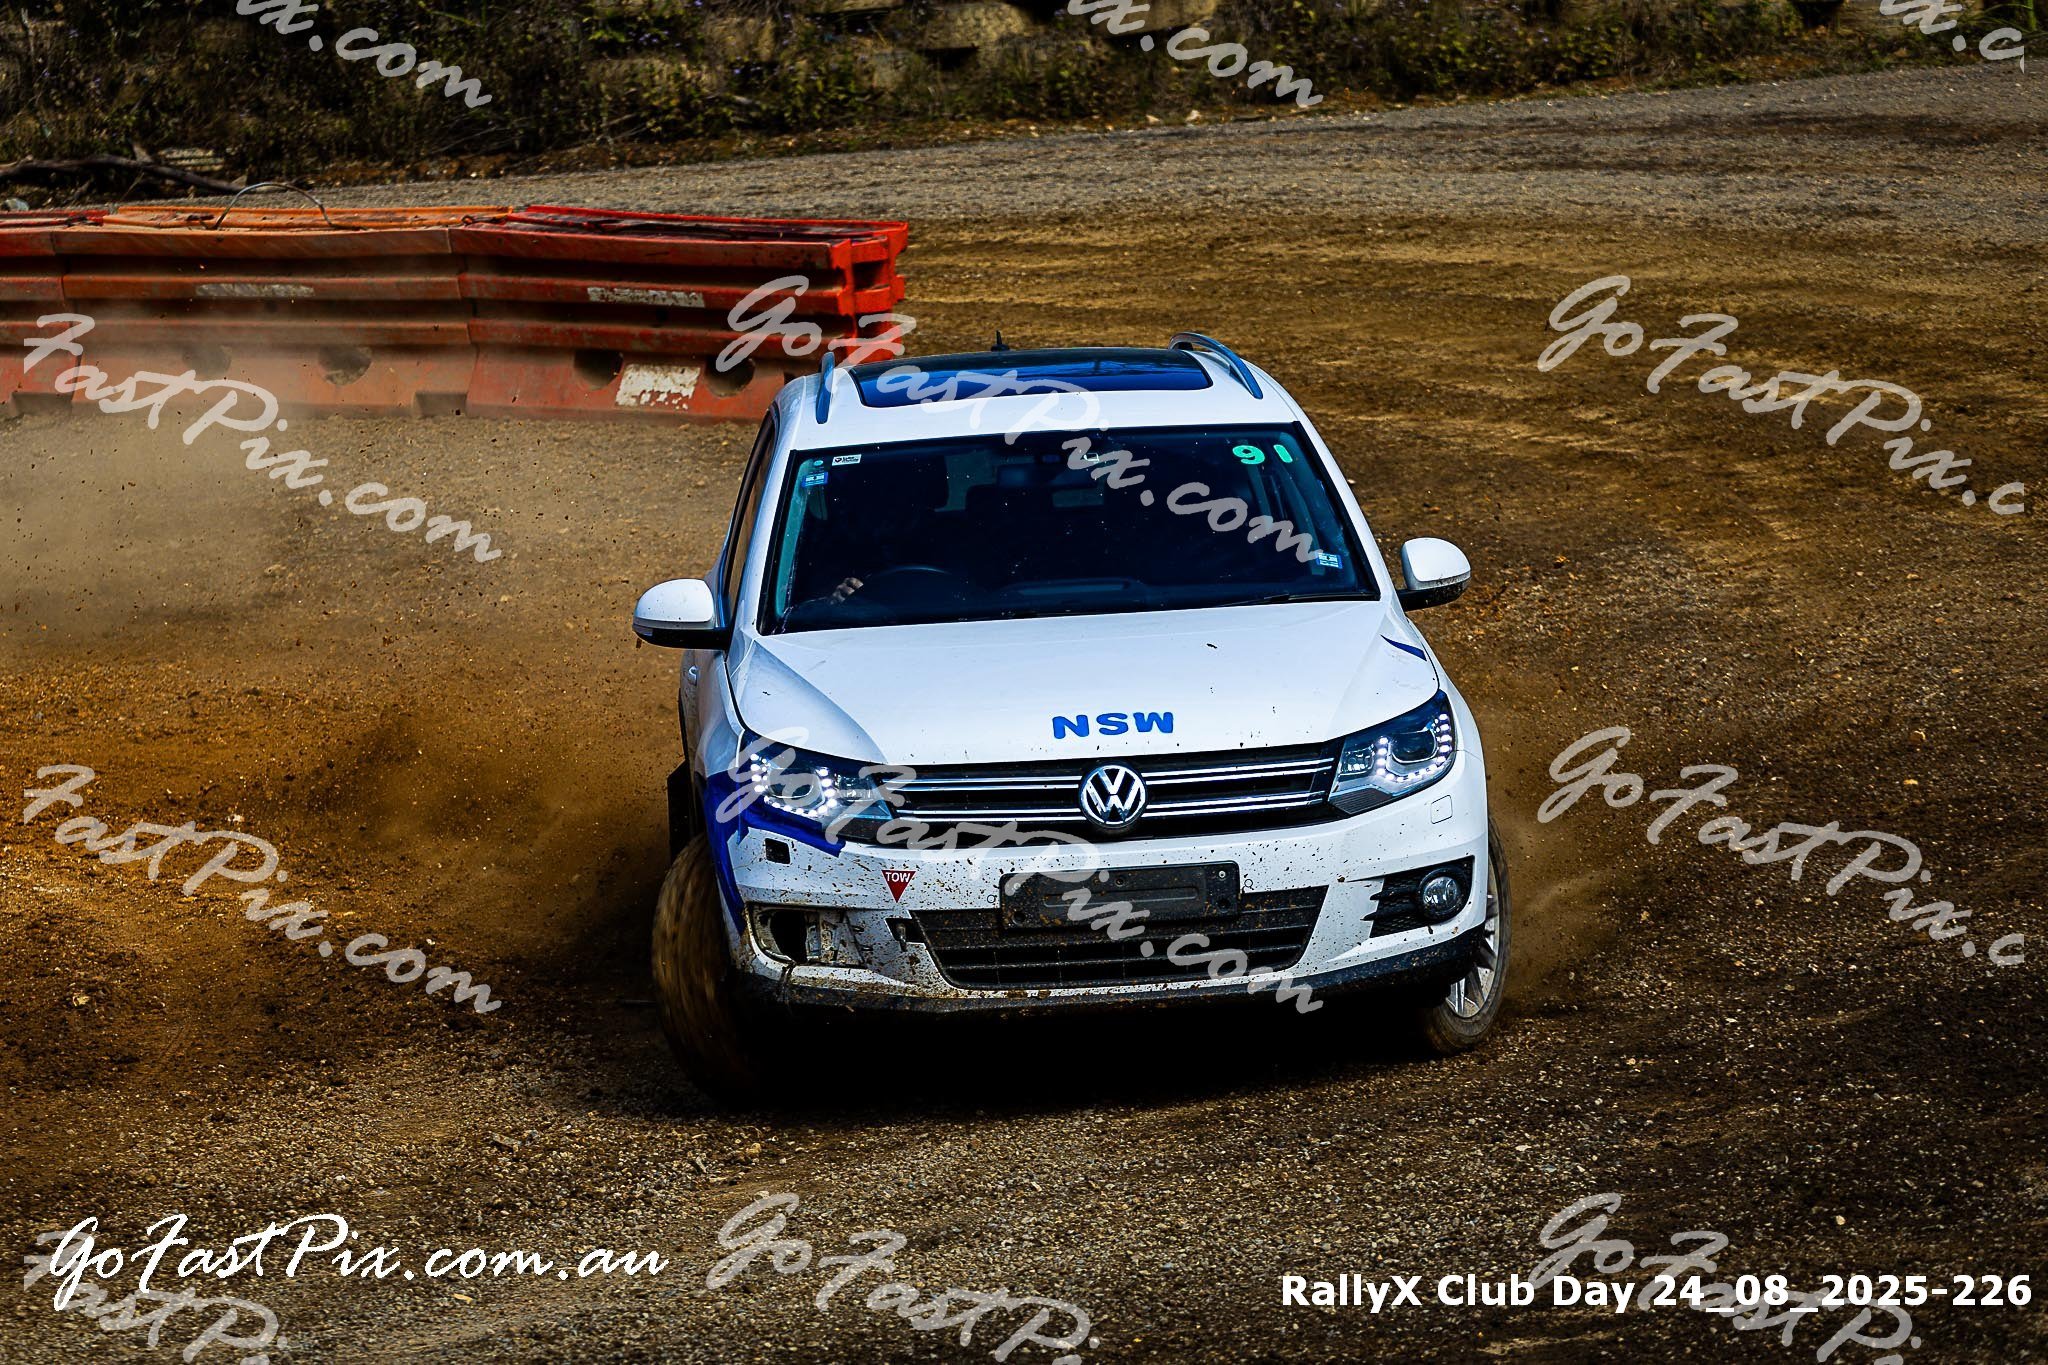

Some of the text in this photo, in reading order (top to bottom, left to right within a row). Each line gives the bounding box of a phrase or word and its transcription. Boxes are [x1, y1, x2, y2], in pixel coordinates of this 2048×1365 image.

[1232, 445, 1293, 465] 91
[1052, 711, 1174, 740] NSW
[885, 872, 911, 883] TOW
